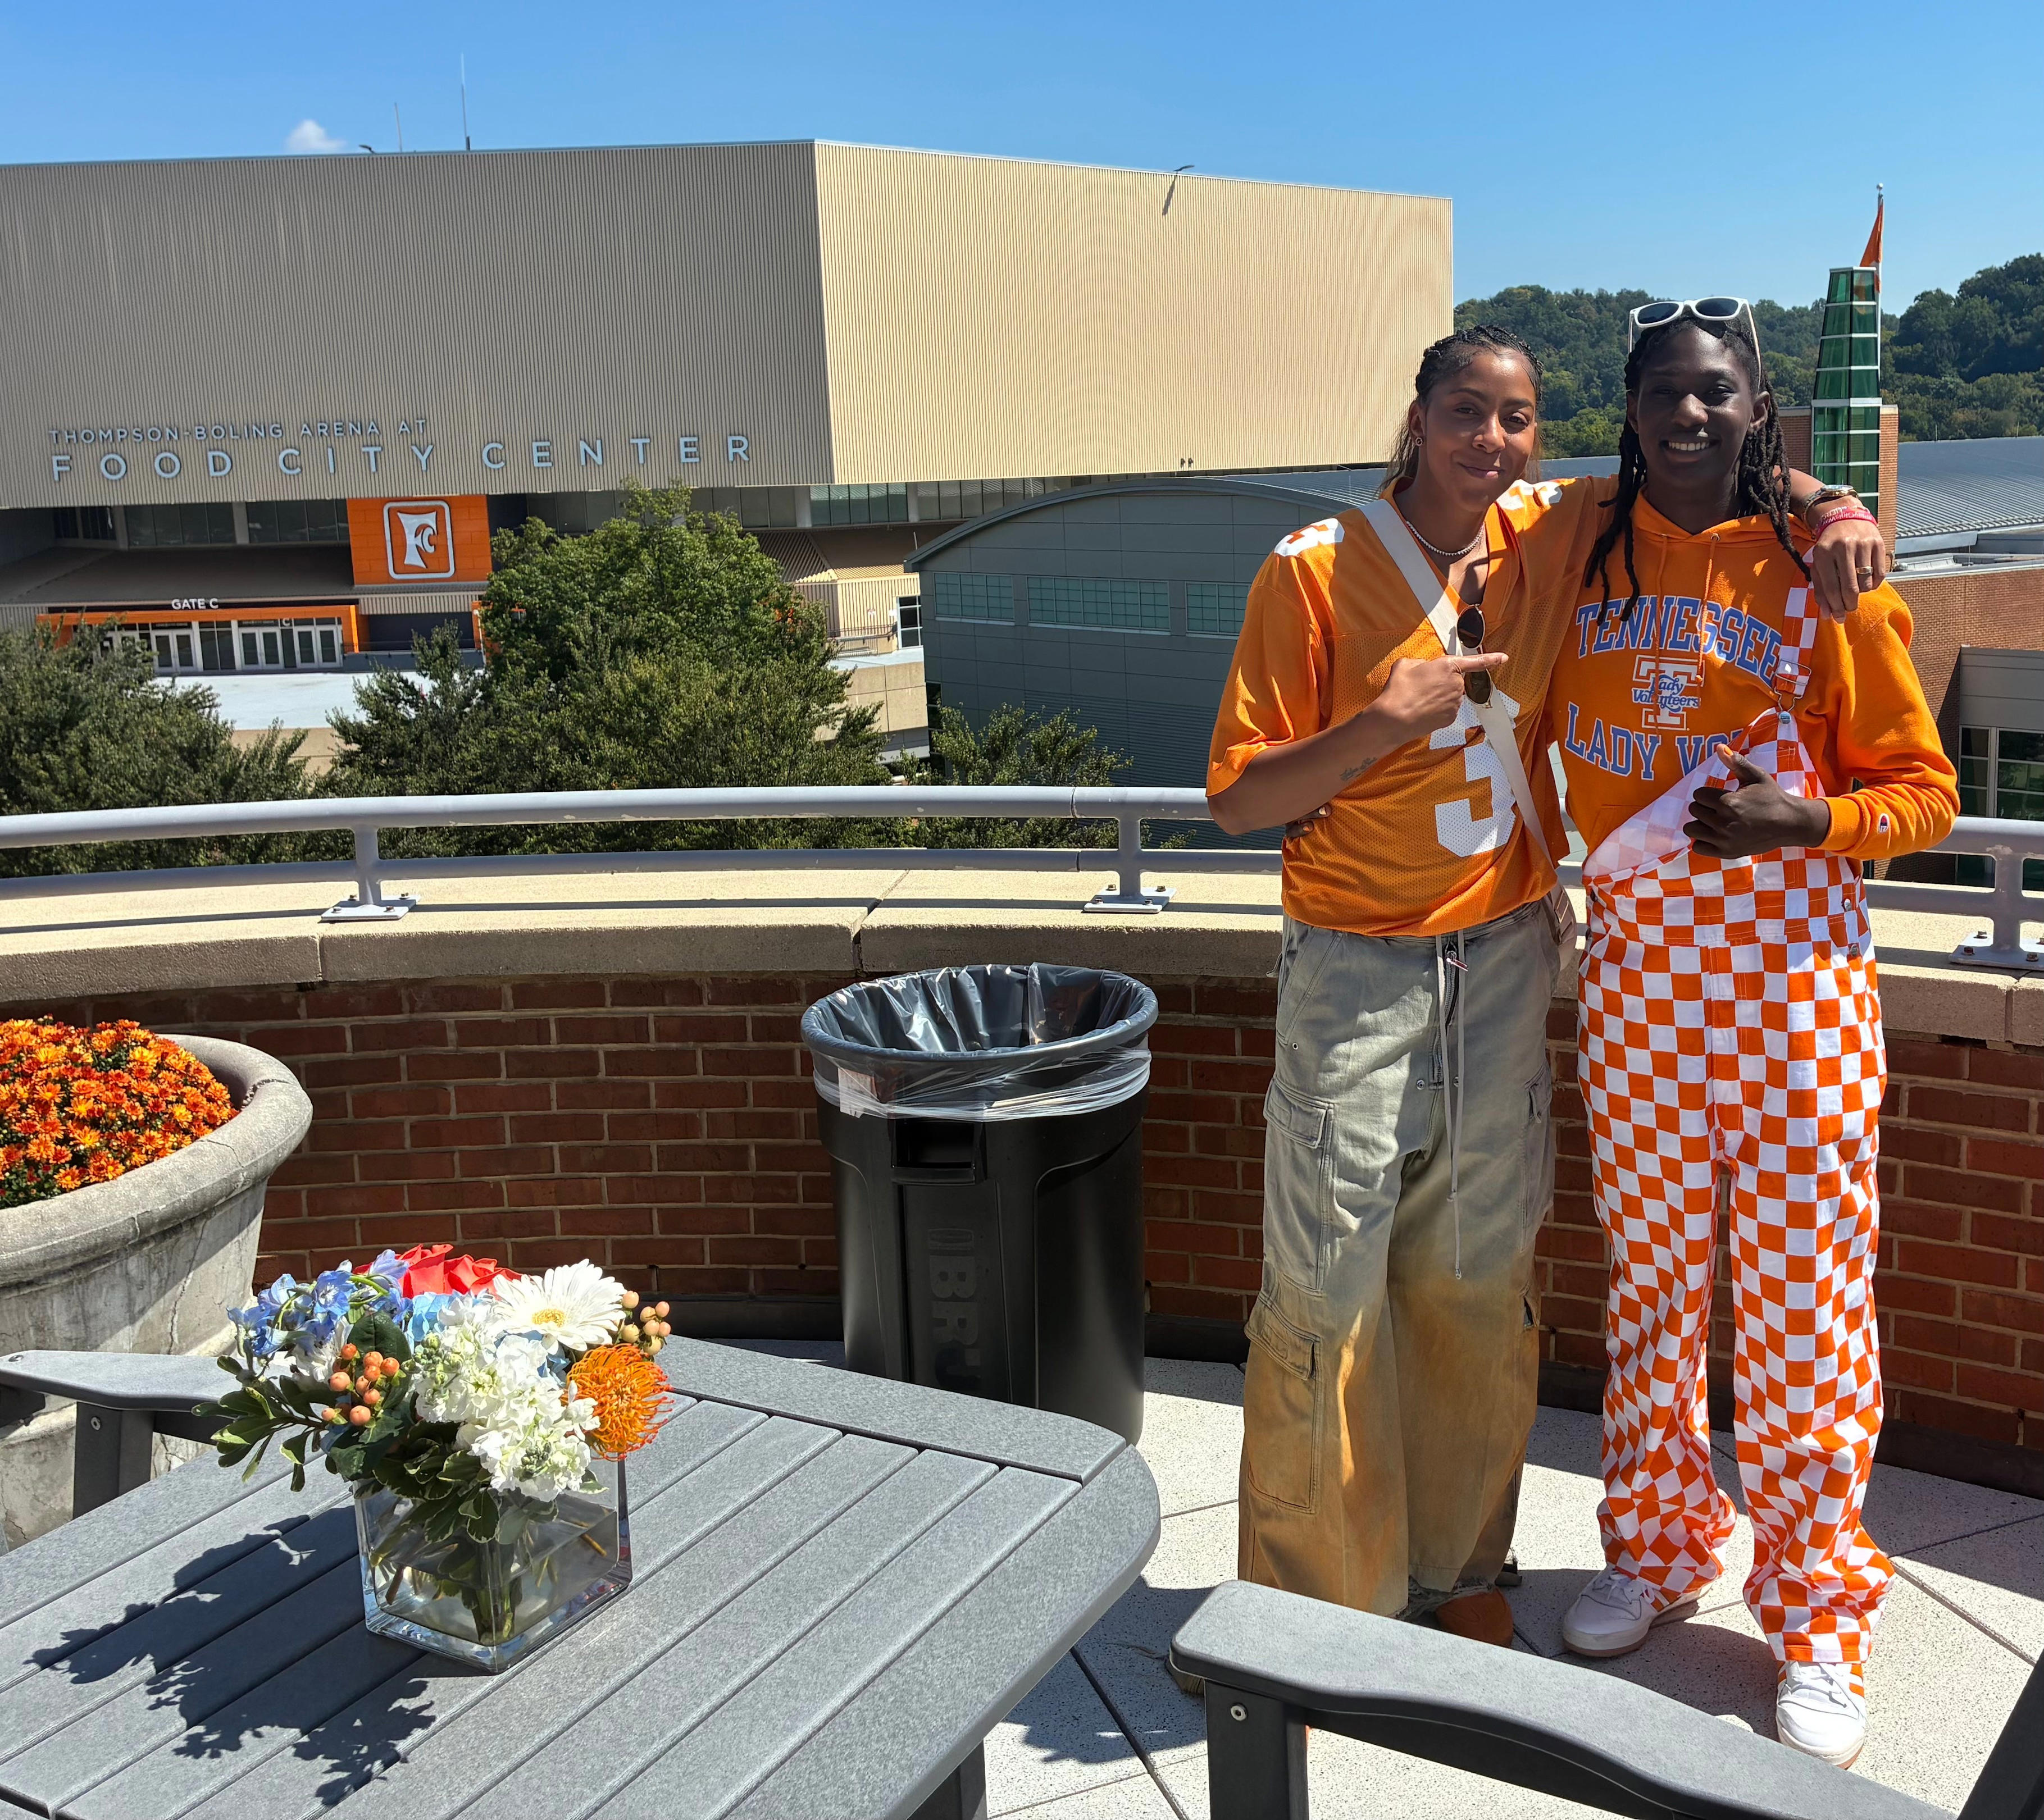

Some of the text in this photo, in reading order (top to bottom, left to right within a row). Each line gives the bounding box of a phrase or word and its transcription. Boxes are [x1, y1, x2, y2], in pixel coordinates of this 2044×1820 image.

[49, 419, 426, 444] THOMPSON-BOLING ARENA AT
[52, 435, 750, 481] FOOD CITY CENTER
[171, 598, 218, 610] GATE C
[282, 617, 290, 627] C
[1576, 595, 1783, 689] TENNESSEE
[1564, 701, 1661, 780] LADY
[1430, 688, 1520, 857] 3
